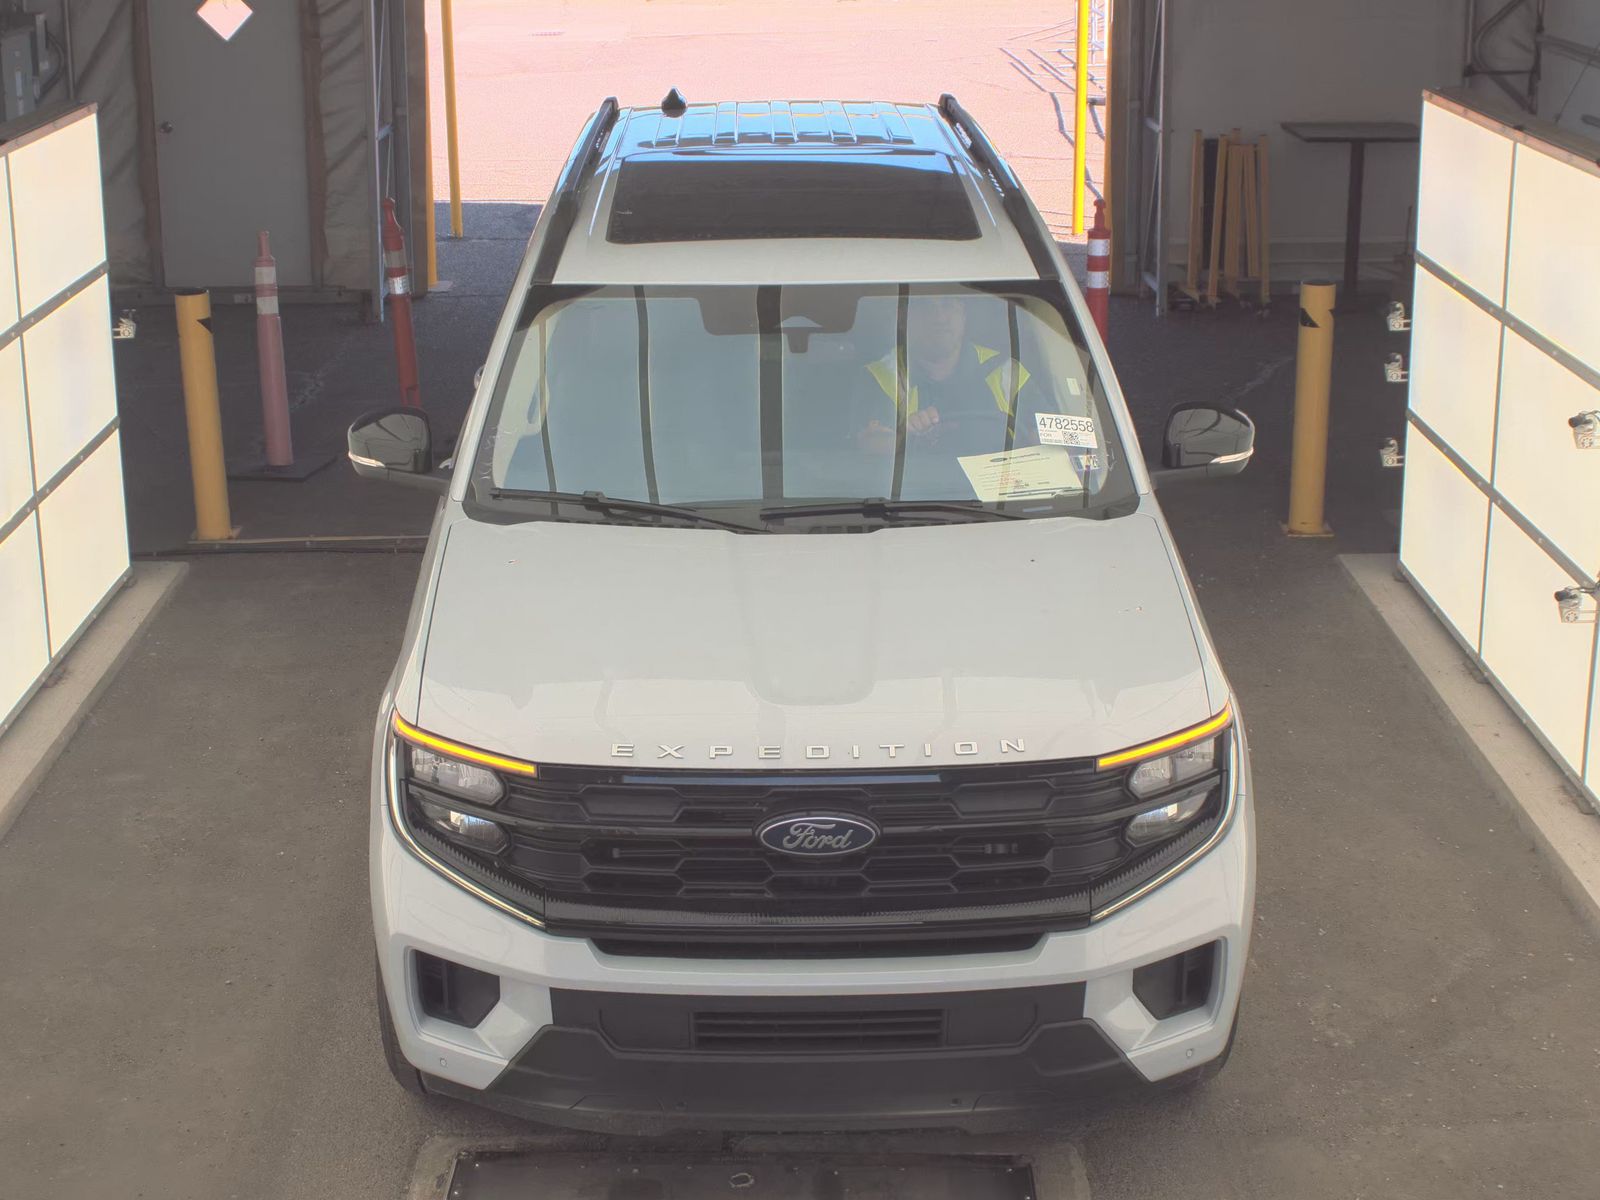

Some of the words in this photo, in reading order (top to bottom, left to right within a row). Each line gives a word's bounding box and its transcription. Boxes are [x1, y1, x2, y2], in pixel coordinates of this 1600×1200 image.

[1039, 417, 1094, 433] 4782558
[611, 738, 1025, 760] EXPEDITION
[782, 822, 854, 849] Ford
